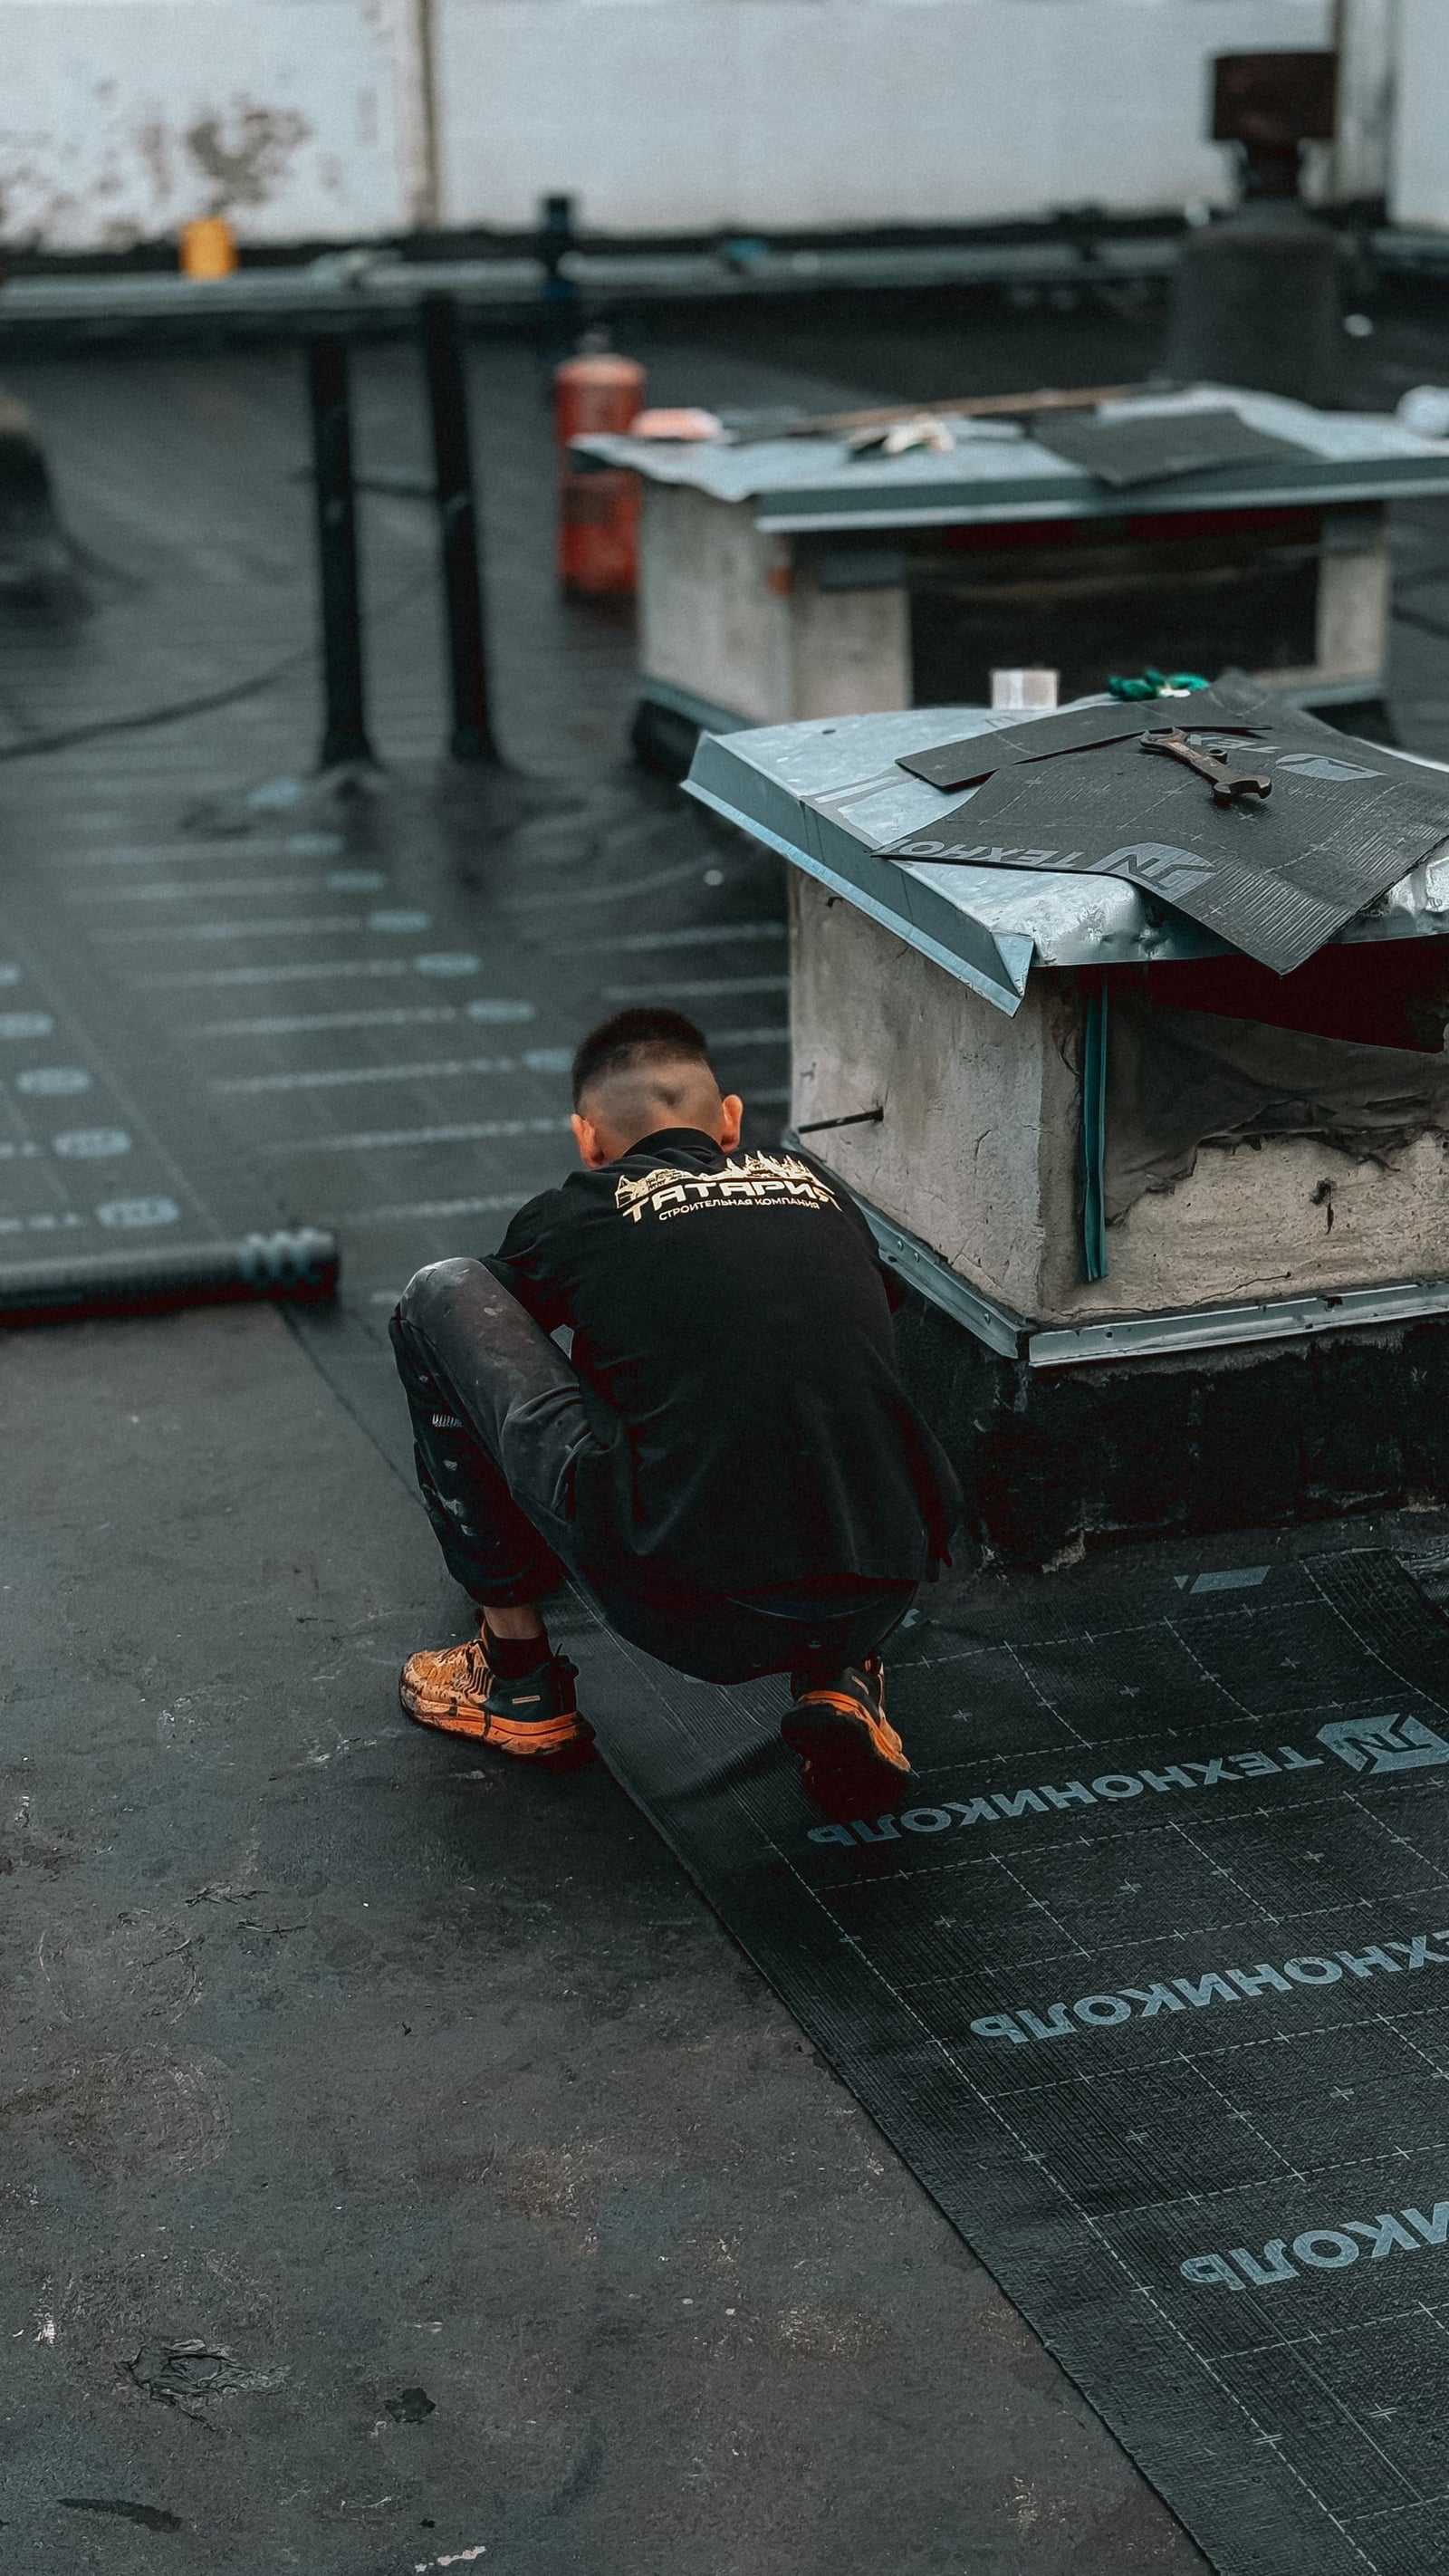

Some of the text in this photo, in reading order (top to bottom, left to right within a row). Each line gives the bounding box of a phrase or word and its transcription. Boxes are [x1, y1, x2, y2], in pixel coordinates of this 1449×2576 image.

[658, 1197, 820, 1221] СТРОИТЕЛЬНАЯ КОМПАНИЯ
[807, 1745, 1325, 1846] ТЕХНОНИКОЛЬ
